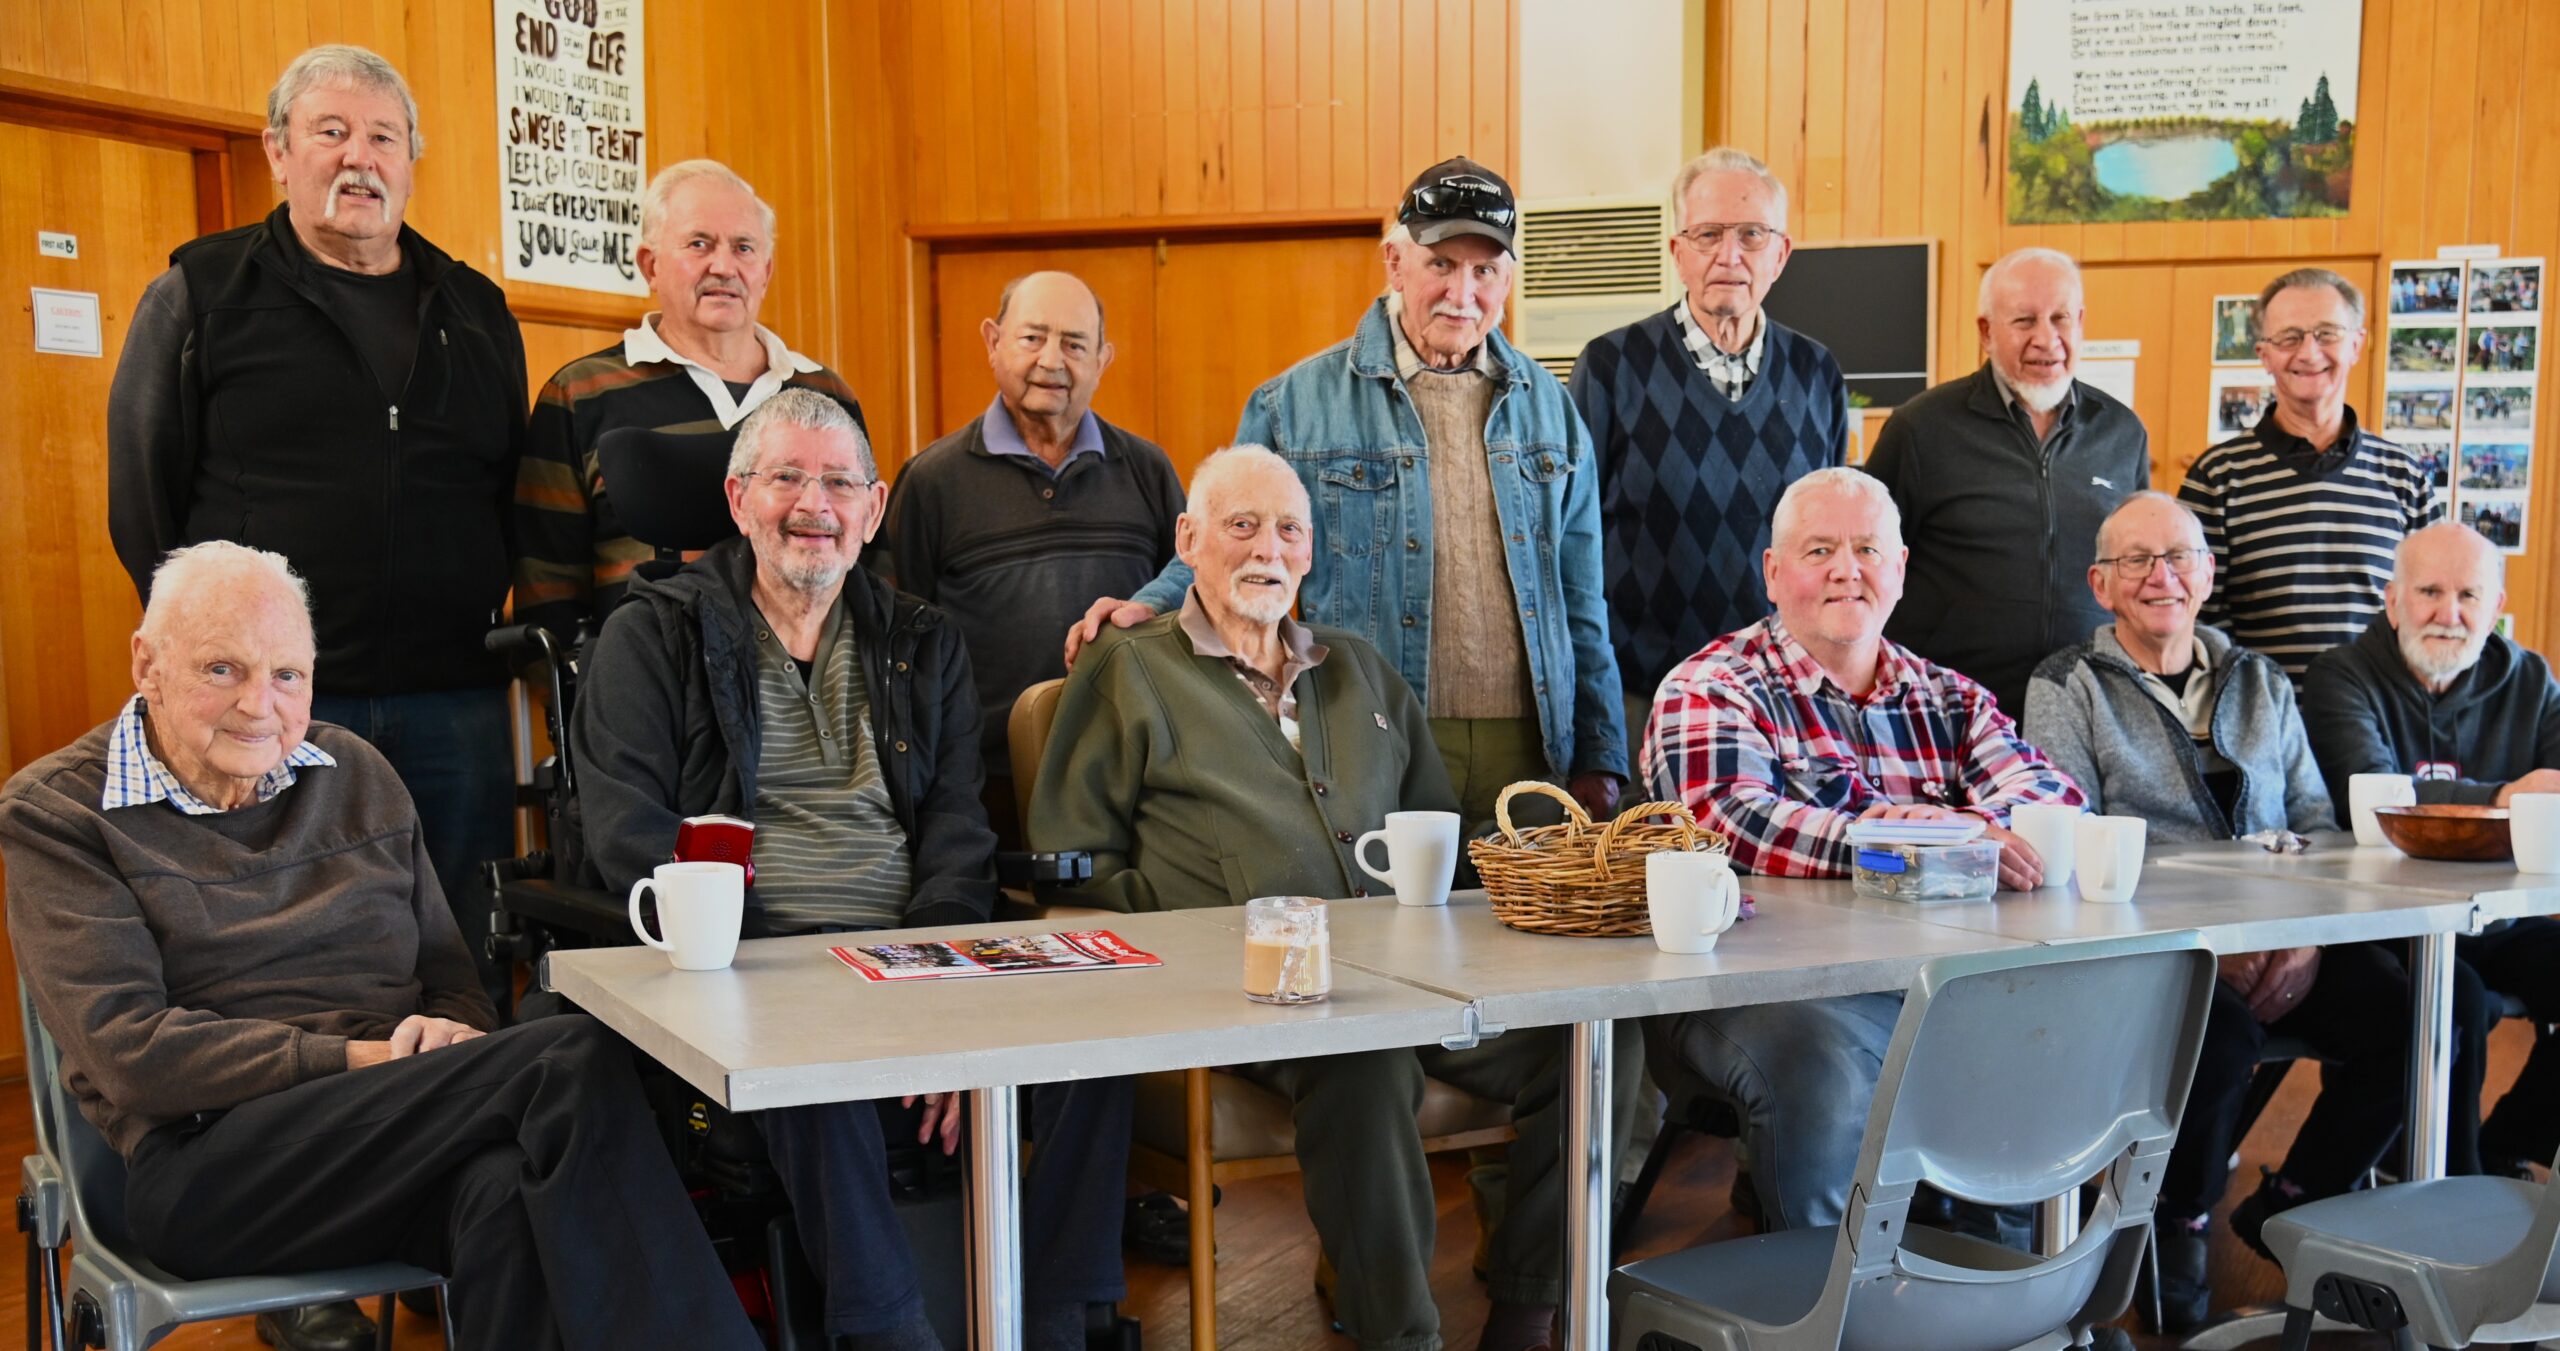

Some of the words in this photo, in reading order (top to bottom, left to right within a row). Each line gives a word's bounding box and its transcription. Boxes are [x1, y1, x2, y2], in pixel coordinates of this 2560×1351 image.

[515, 12, 557, 59] END
[514, 57, 519, 77] I
[523, 61, 566, 87] WOULD
[573, 72, 599, 94] HOPE
[603, 80, 630, 101] THAT
[514, 85, 519, 101] I
[522, 86, 561, 113] WOULD
[593, 102, 619, 122] HAVE
[545, 156, 560, 184] &
[563, 159, 568, 176] I
[613, 169, 638, 193] SAY
[511, 190, 519, 210] I
[553, 192, 641, 226] EVERYTHING
[518, 220, 567, 267] YOU
[602, 231, 635, 280] ME
